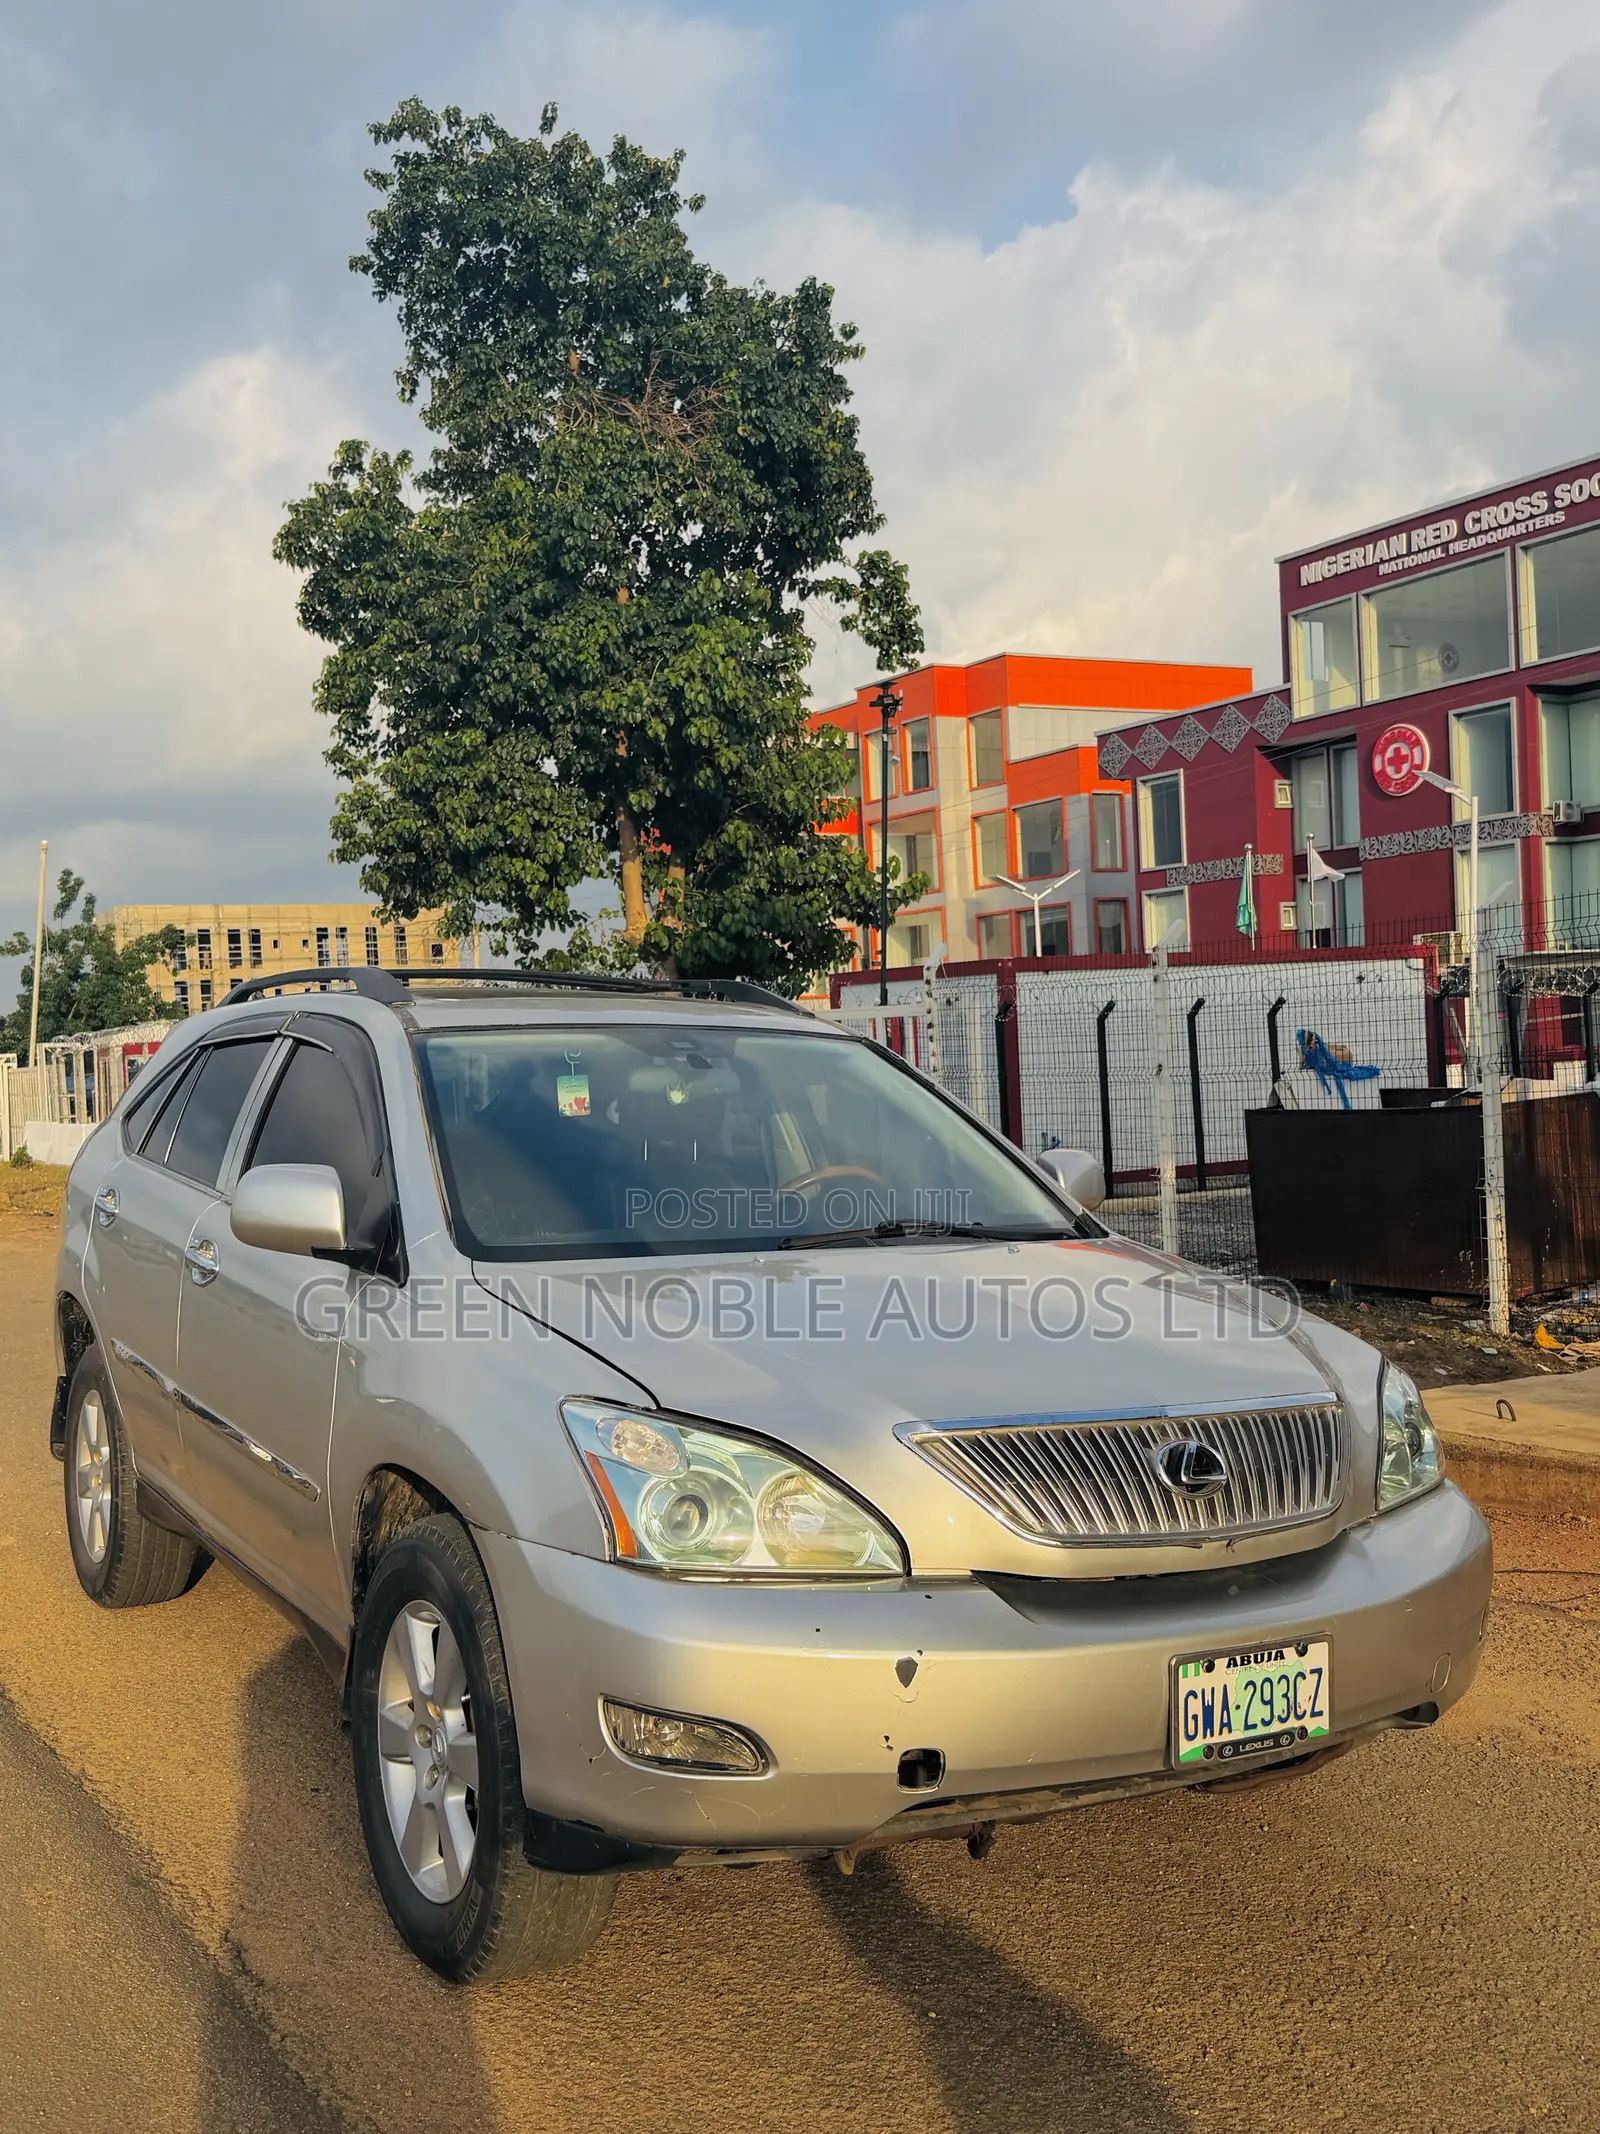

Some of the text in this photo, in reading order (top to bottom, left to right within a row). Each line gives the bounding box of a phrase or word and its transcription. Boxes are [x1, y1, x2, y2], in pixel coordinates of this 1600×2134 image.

[1300, 532, 1407, 587] NIGERIAN
[1410, 519, 1458, 553] RED
[1464, 490, 1548, 535] CROSS
[1378, 510, 1566, 576] NATIONAL HEADQUARTERS
[1226, 1650, 1285, 1668] ABUJA
[1239, 1739, 1274, 1752] LEXUS
